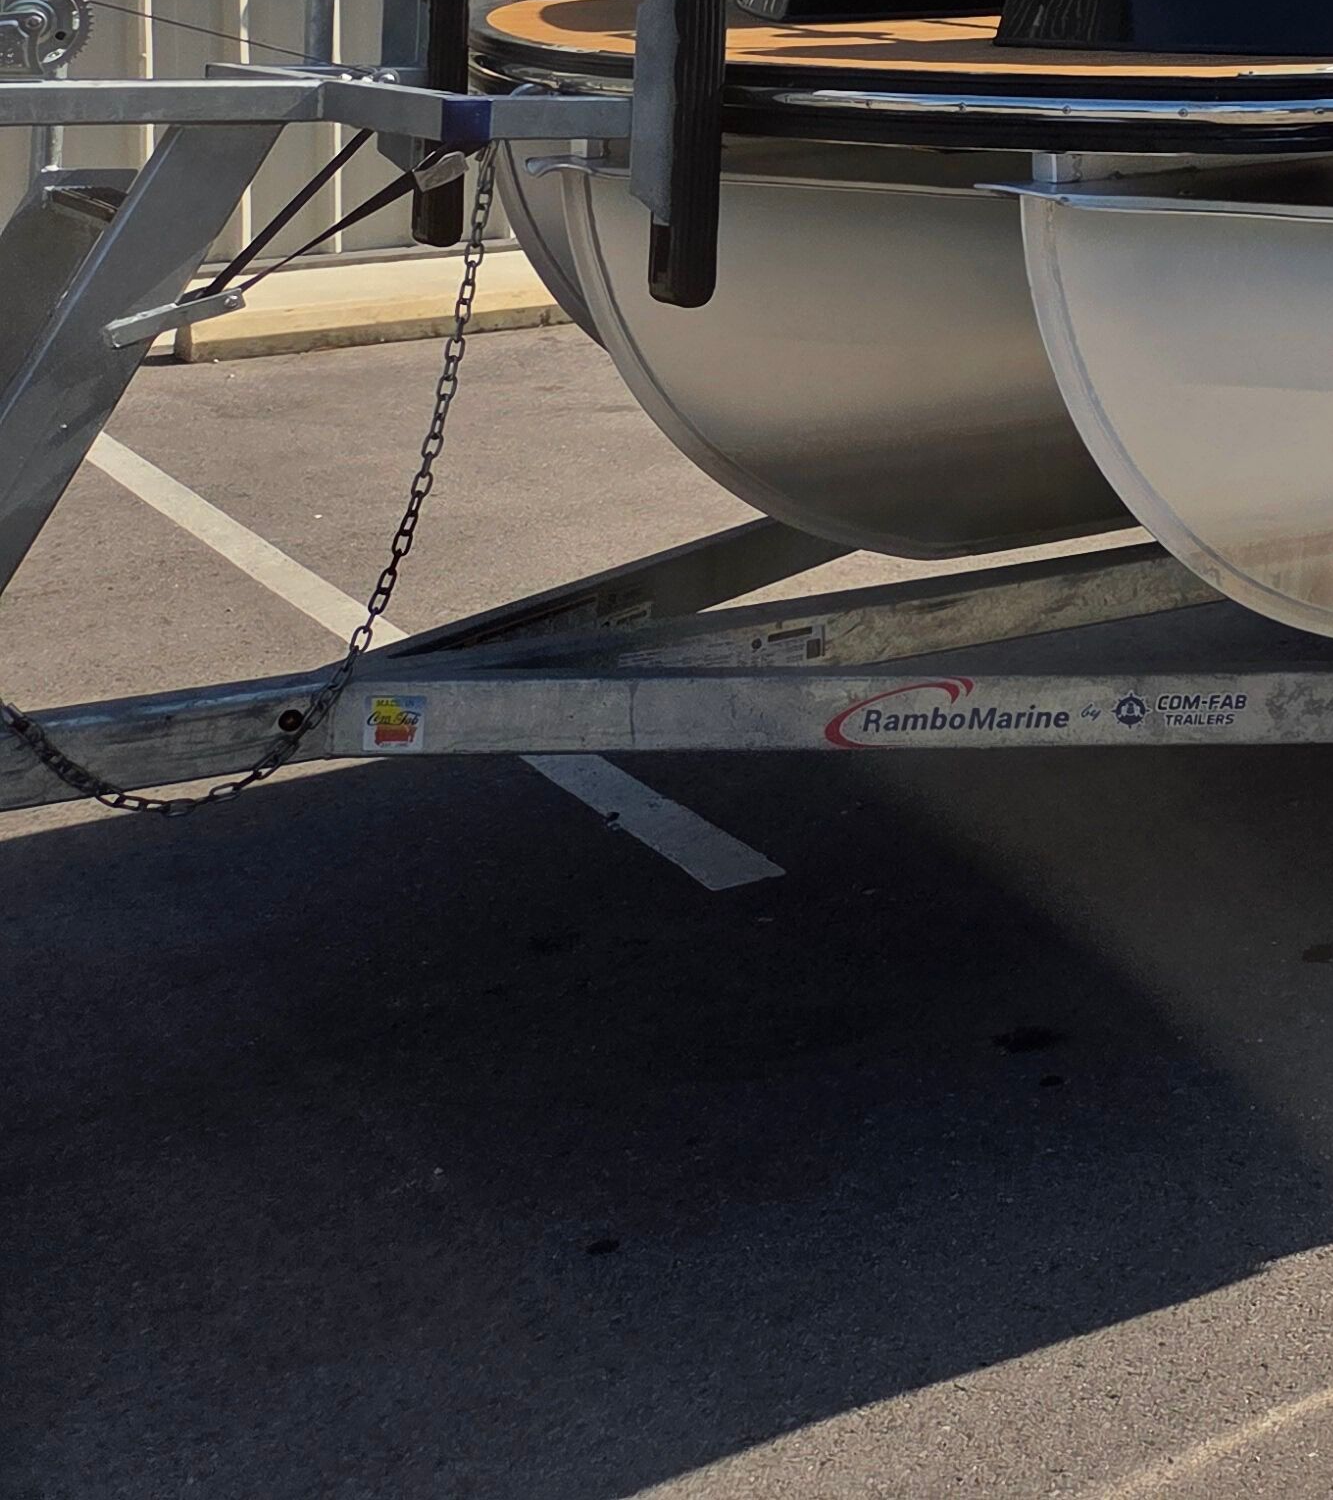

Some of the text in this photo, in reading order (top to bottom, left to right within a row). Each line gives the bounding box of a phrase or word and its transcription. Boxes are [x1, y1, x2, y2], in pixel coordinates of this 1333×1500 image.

[1157, 694, 1248, 711] COM-FAB
[862, 703, 1101, 733] RamboMarine by
[1165, 713, 1235, 726] TRAILERS
